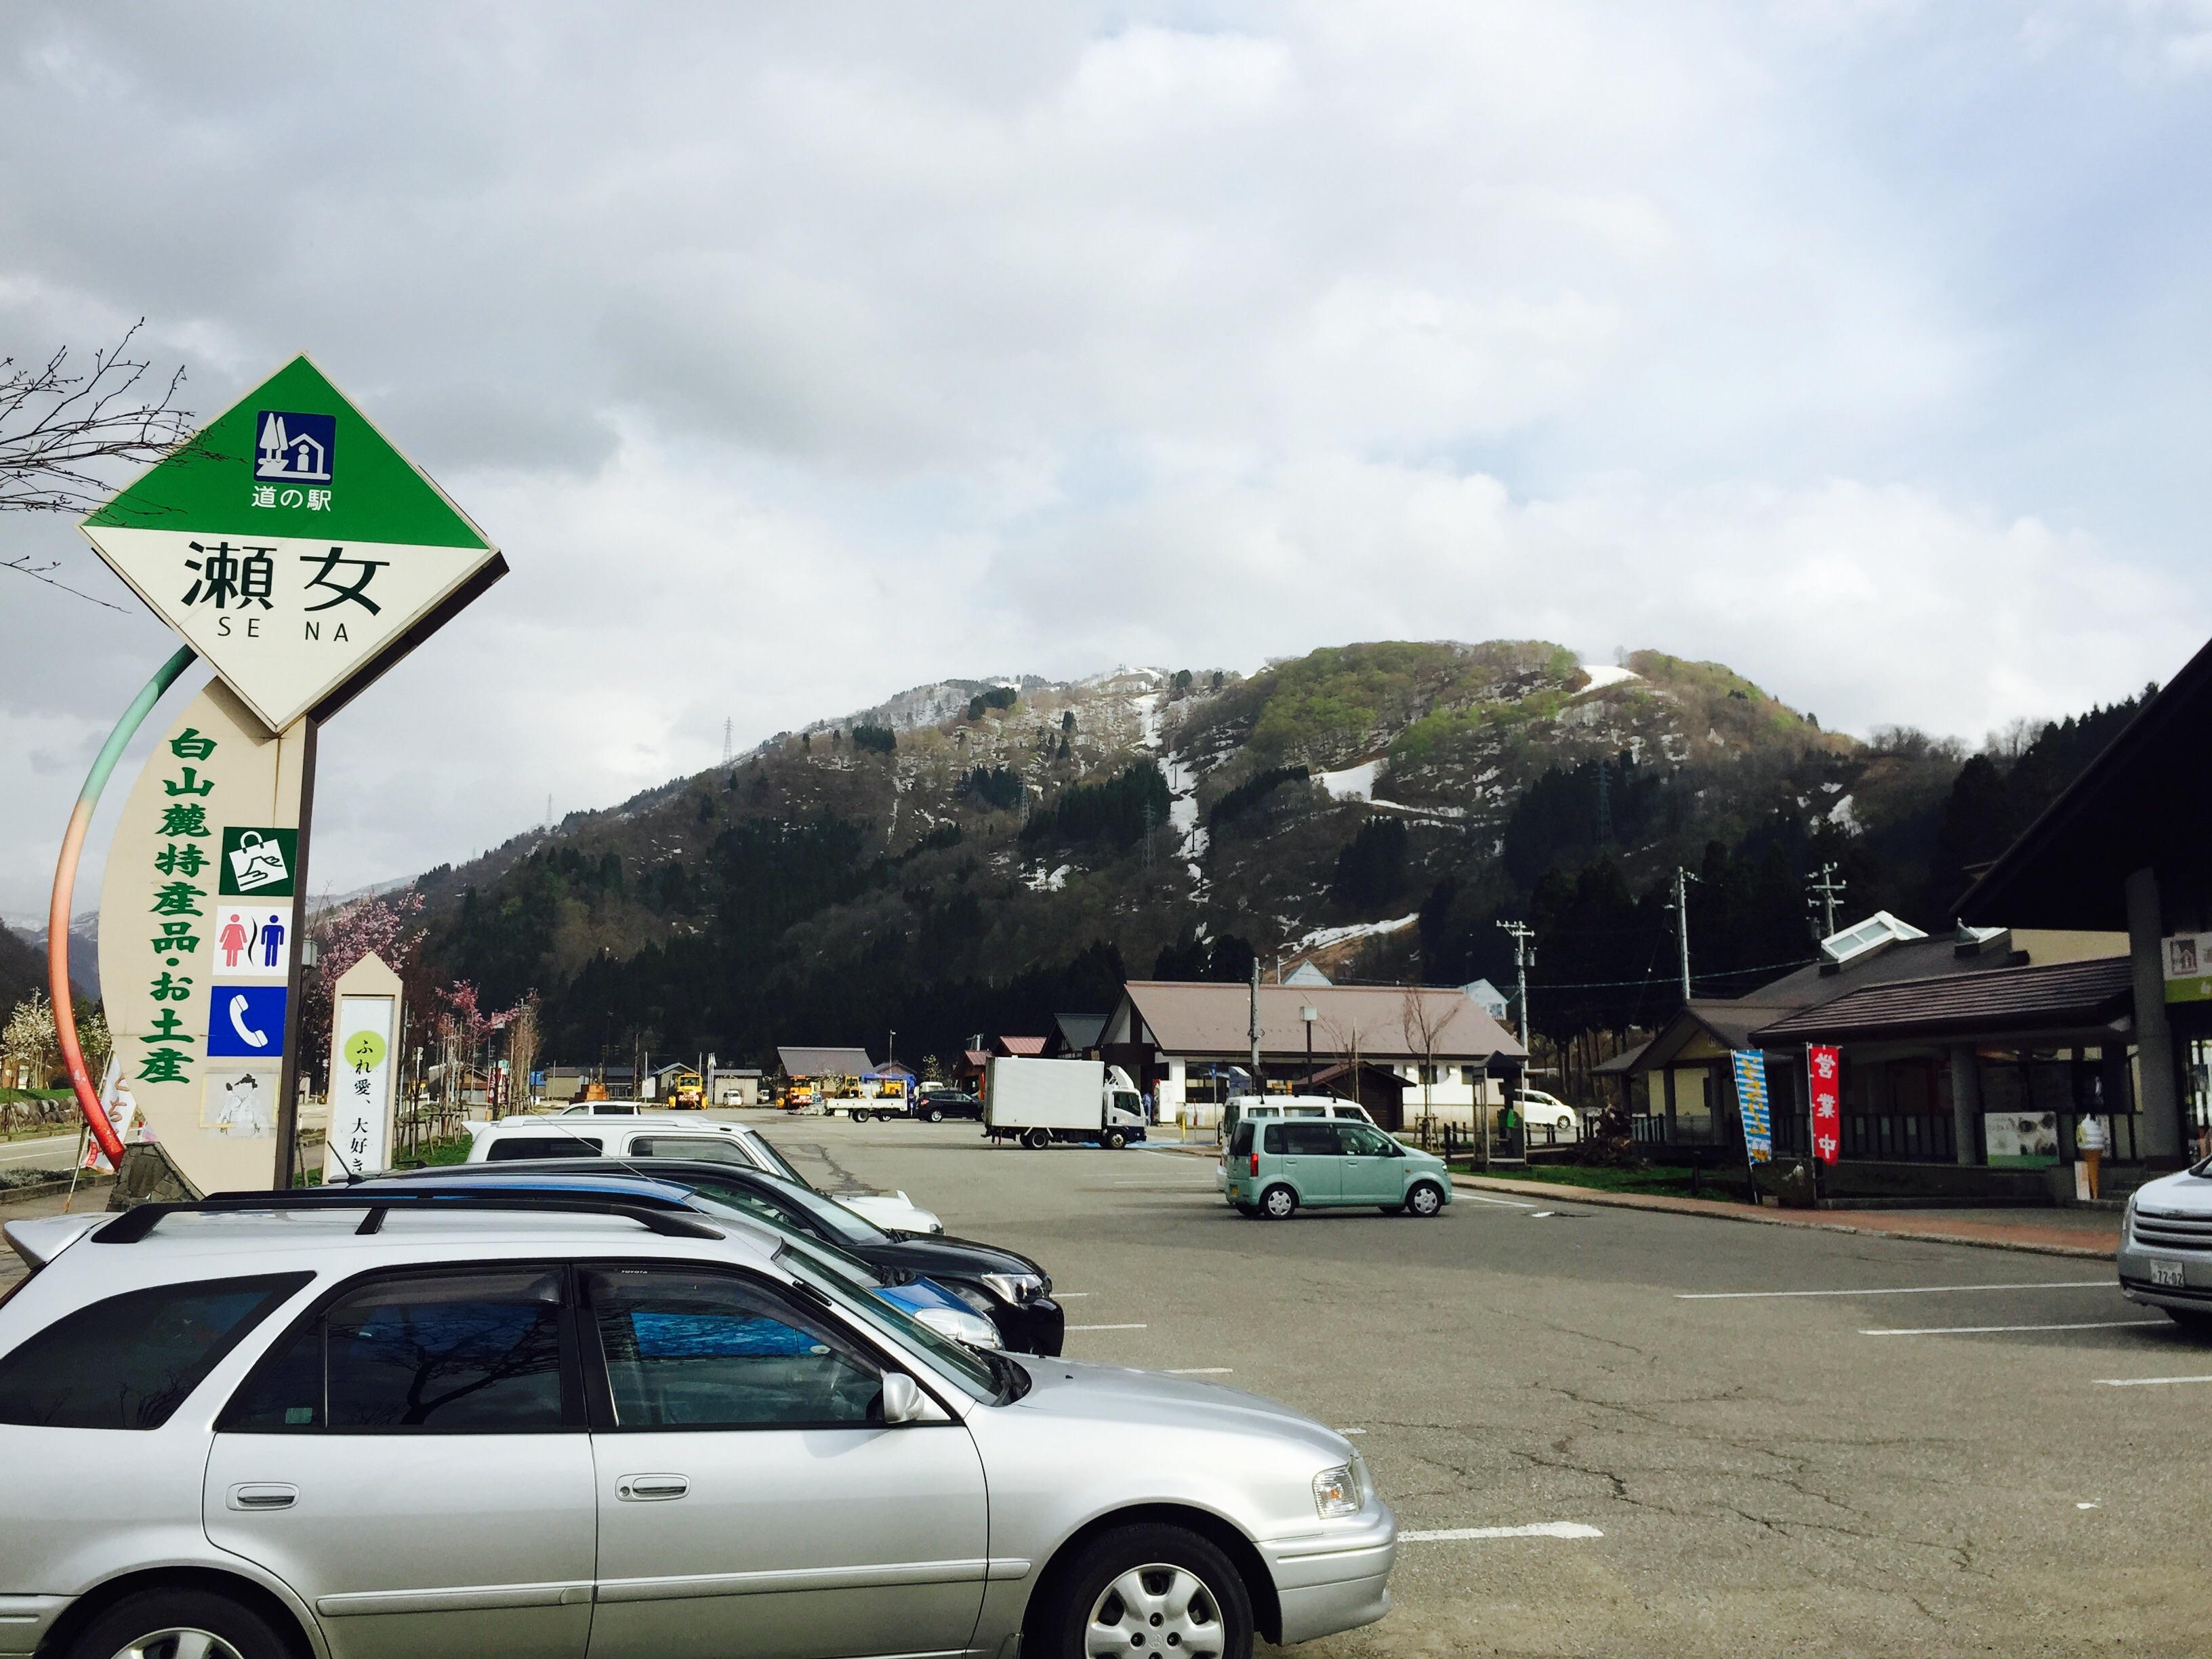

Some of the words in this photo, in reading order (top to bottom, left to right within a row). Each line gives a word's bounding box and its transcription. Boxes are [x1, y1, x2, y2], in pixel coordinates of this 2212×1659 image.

[251, 485, 331, 512] 道の駅
[181, 541, 390, 616] 瀬女
[218, 616, 261, 638] SE
[305, 621, 349, 642] NA
